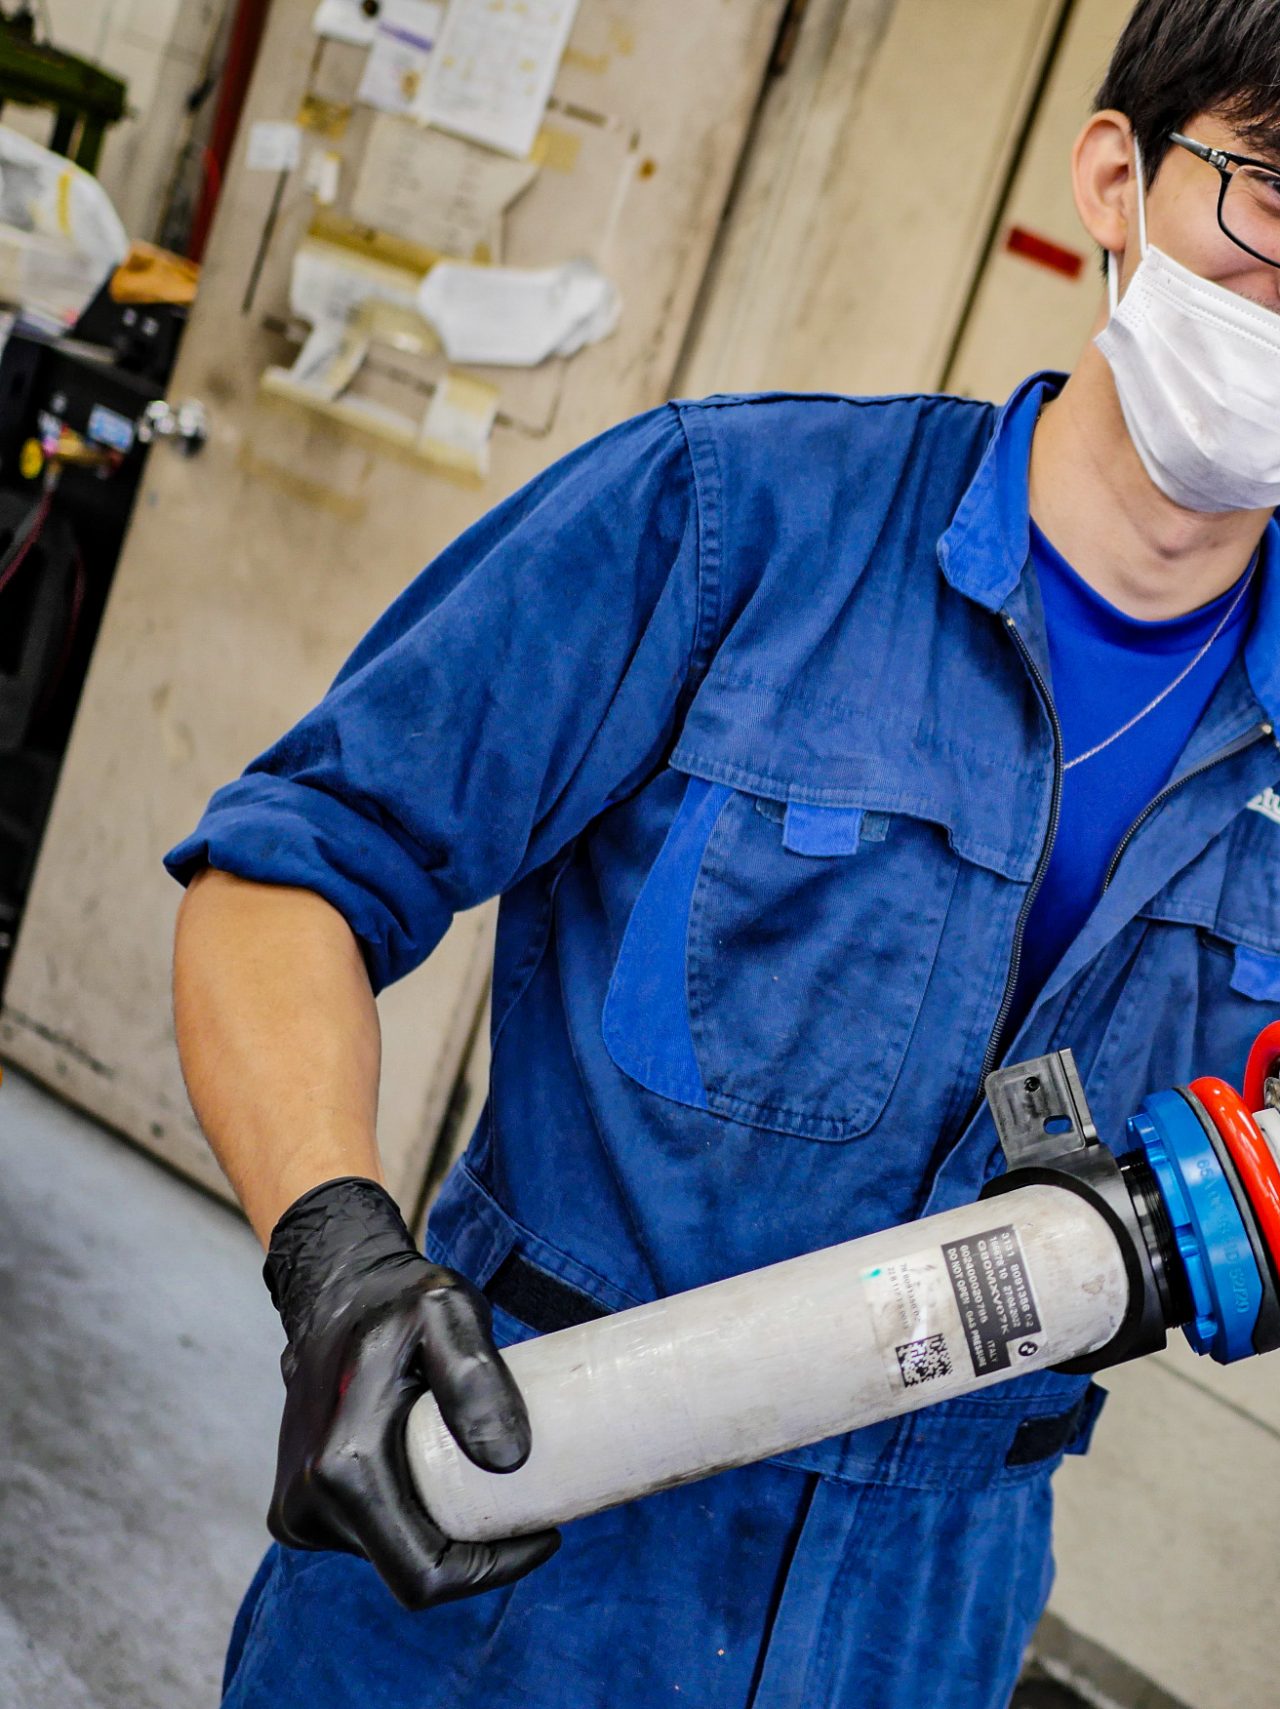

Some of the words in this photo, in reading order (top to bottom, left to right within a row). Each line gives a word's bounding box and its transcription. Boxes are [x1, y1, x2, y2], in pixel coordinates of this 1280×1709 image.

[946, 1247, 958, 1261] DO
[949, 1260, 963, 1280] NOT
[955, 1279, 970, 1304] OPEN
[963, 1310, 976, 1329] GAS
[968, 1329, 987, 1367] PRESSURE
[985, 1339, 1000, 1363] ITALY
